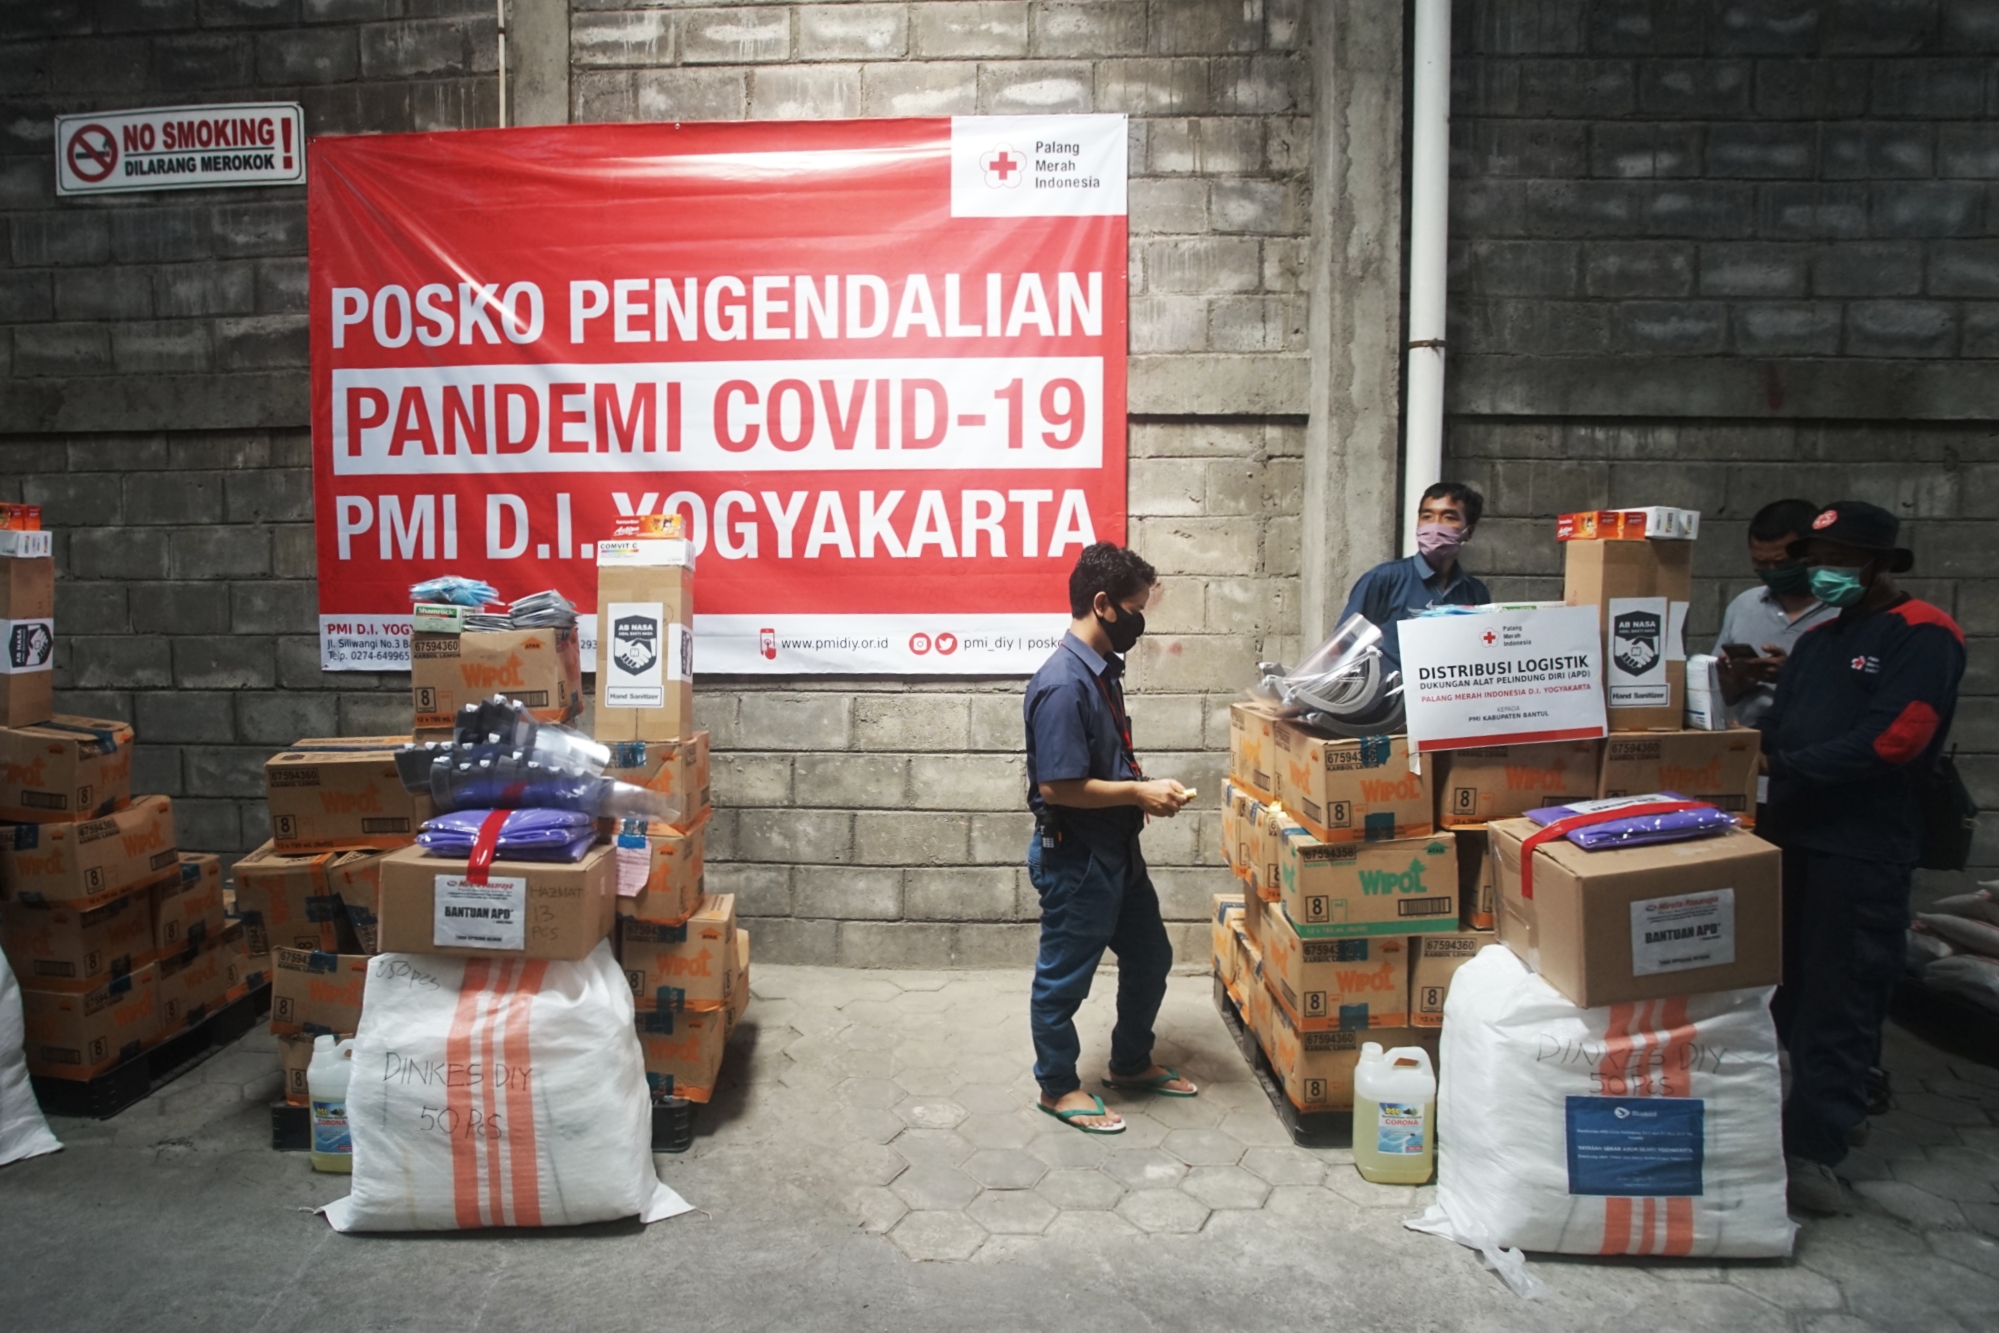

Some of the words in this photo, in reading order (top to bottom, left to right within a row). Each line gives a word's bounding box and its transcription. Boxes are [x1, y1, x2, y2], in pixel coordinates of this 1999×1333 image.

[123, 124, 157, 152] NO
[162, 117, 275, 150] SMOKING
[1035, 141, 1080, 157] Palang
[125, 154, 197, 177] DILARANG
[200, 152, 275, 173] MEROKOK
[1035, 160, 1076, 172] Merah
[1035, 175, 1101, 189] Indonesia
[331, 281, 545, 349] POSKO
[569, 271, 1103, 345] PENGENDALIAN
[346, 381, 682, 457] PANDEMI
[712, 376, 1086, 453] COVID-19
[336, 494, 458, 560] PMI
[486, 492, 594, 560] D.I.
[418, 607, 454, 616] Shamrock
[327, 624, 352, 635] PMI
[357, 624, 378, 635] D.I.
[1632, 620, 1656, 628] NASA
[327, 639, 336, 650] Jl.
[339, 639, 378, 650] Siliwangi
[381, 639, 400, 649] No.3
[415, 641, 458, 651] 67594360
[781, 637, 889, 651] www.pmidiy.or.id
[964, 637, 1014, 652] pmi_diy
[1503, 639, 1532, 647] Indonesia
[328, 651, 348, 661] Telp.
[1419, 661, 1512, 680] DISTRIBUSI
[1518, 655, 1589, 673] LOGISTIK
[1420, 680, 1471, 690] DUKUNGAN
[1473, 677, 1495, 687] ALAT
[1497, 674, 1546, 685] PELINDUNG
[1548, 672, 1565, 681] DIRI
[1567, 670, 1591, 680] (APD)
[421, 690, 430, 706] 8
[1421, 694, 1453, 703] PALANG
[1455, 692, 1482, 701] MERAH
[1484, 689, 1527, 699] INDONESIA
[1528, 687, 1541, 695] D.I.
[1543, 683, 1592, 694] YOGYAKARTA
[1483, 713, 1522, 721] KABUPATEN
[1523, 710, 1549, 718] BANTUL
[1497, 705, 1520, 713] KEPADA
[1611, 742, 1659, 753] 67594360
[1326, 764, 1354, 772] KARBOL
[1360, 774, 1421, 803] WIPOL
[1460, 790, 1469, 808] 8
[1335, 804, 1344, 821] 8
[281, 817, 290, 833] 8
[91, 869, 98, 884] 8
[1358, 866, 1428, 896] WIPOL
[444, 905, 489, 919] BANTUAN
[533, 904, 555, 922] 13
[1312, 898, 1322, 915] 8
[1645, 926, 1695, 944] BANTUAN
[1427, 939, 1475, 950] 67594360
[630, 971, 639, 989] 8
[1335, 966, 1395, 993] WIPOL
[1310, 993, 1320, 1011] 8
[1428, 988, 1437, 1006] 8
[279, 999, 288, 1014] 8
[1306, 1033, 1354, 1045] 67594360
[1537, 1034, 1666, 1070] DINKES
[1680, 1042, 1728, 1074] DIY
[383, 1052, 484, 1088] DINKES
[496, 1063, 533, 1091] DIY
[1311, 1081, 1321, 1097] 8
[1589, 1072, 1626, 1095] 50
[421, 1106, 460, 1133] 50
[1385, 1118, 1419, 1126] CORONA
